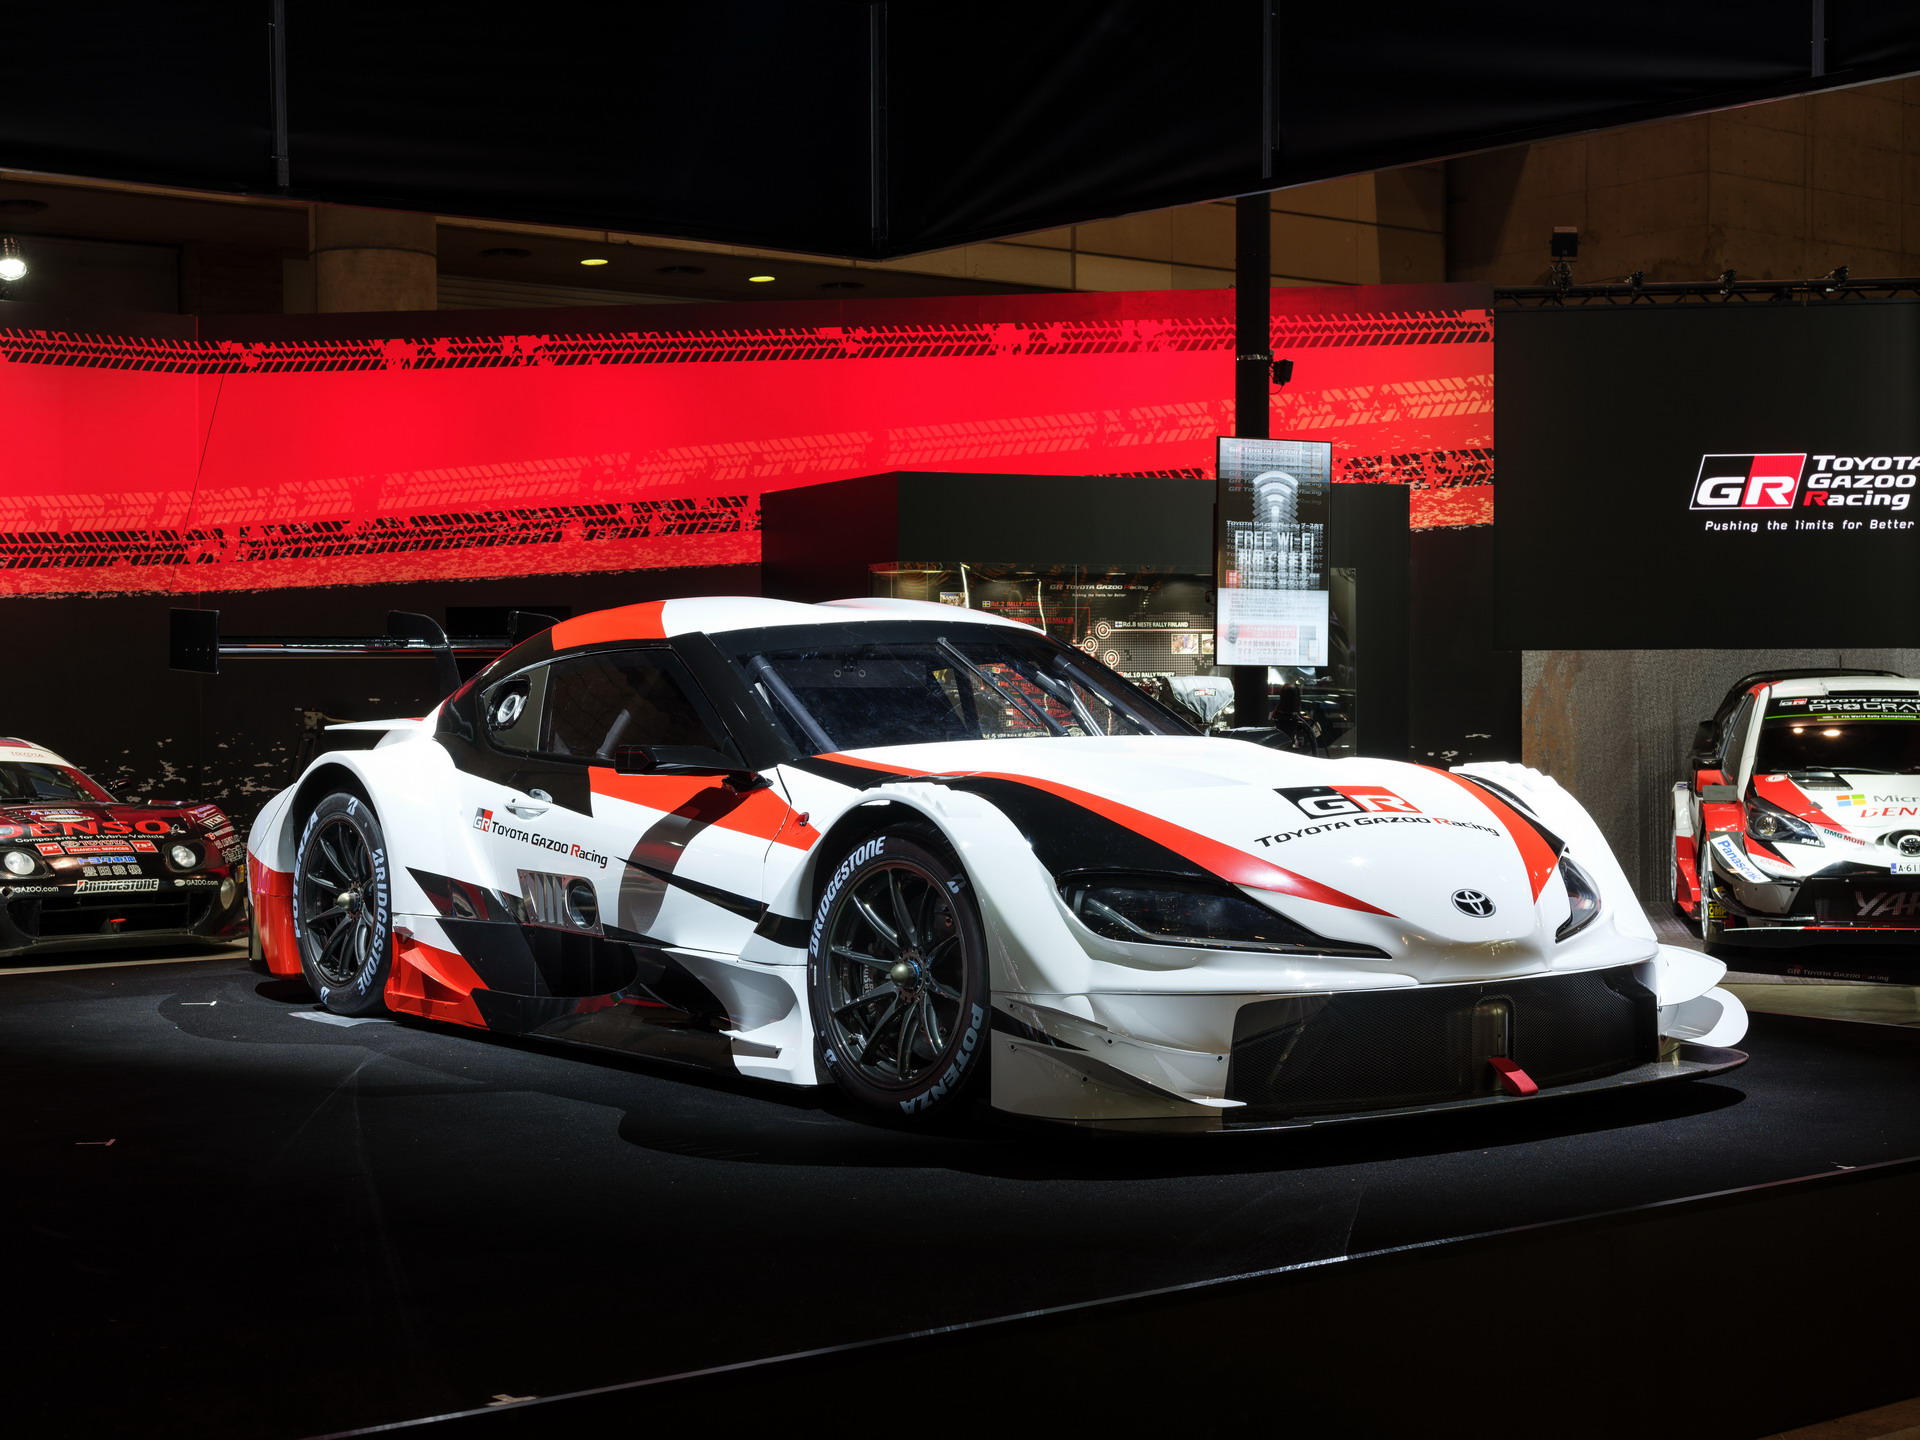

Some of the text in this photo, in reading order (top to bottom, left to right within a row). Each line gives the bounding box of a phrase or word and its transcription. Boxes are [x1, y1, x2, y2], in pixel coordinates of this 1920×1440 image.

[1696, 473, 1917, 505] GR GAZOO
[1802, 489, 1911, 511] Racing
[1704, 518, 1915, 533] Pushing the limits for Better
[1234, 530, 1273, 546] FREE
[1297, 793, 1417, 818] GR
[1860, 806, 1920, 818] DEN
[1254, 816, 1500, 847] TOYOTA GAZOO Racing
[1801, 837, 1820, 846] PIAA
[1823, 828, 1866, 846] DMG MORI
[492, 821, 529, 843] TOYOTA
[531, 833, 569, 854] GAZOO
[570, 843, 608, 869] Racing
[1717, 839, 1762, 881] Panasonic
[14, 885, 59, 893] GAZOO.com
[77, 880, 158, 893] BRIDGESTONE
[809, 835, 886, 958] BRIDGESTONE
[358, 848, 388, 996] BRIDGESTONE
[1802, 969, 1832, 977] TOYOTA
[1833, 971, 1860, 979] GAZOO
[900, 1002, 984, 1116] POTENZA
